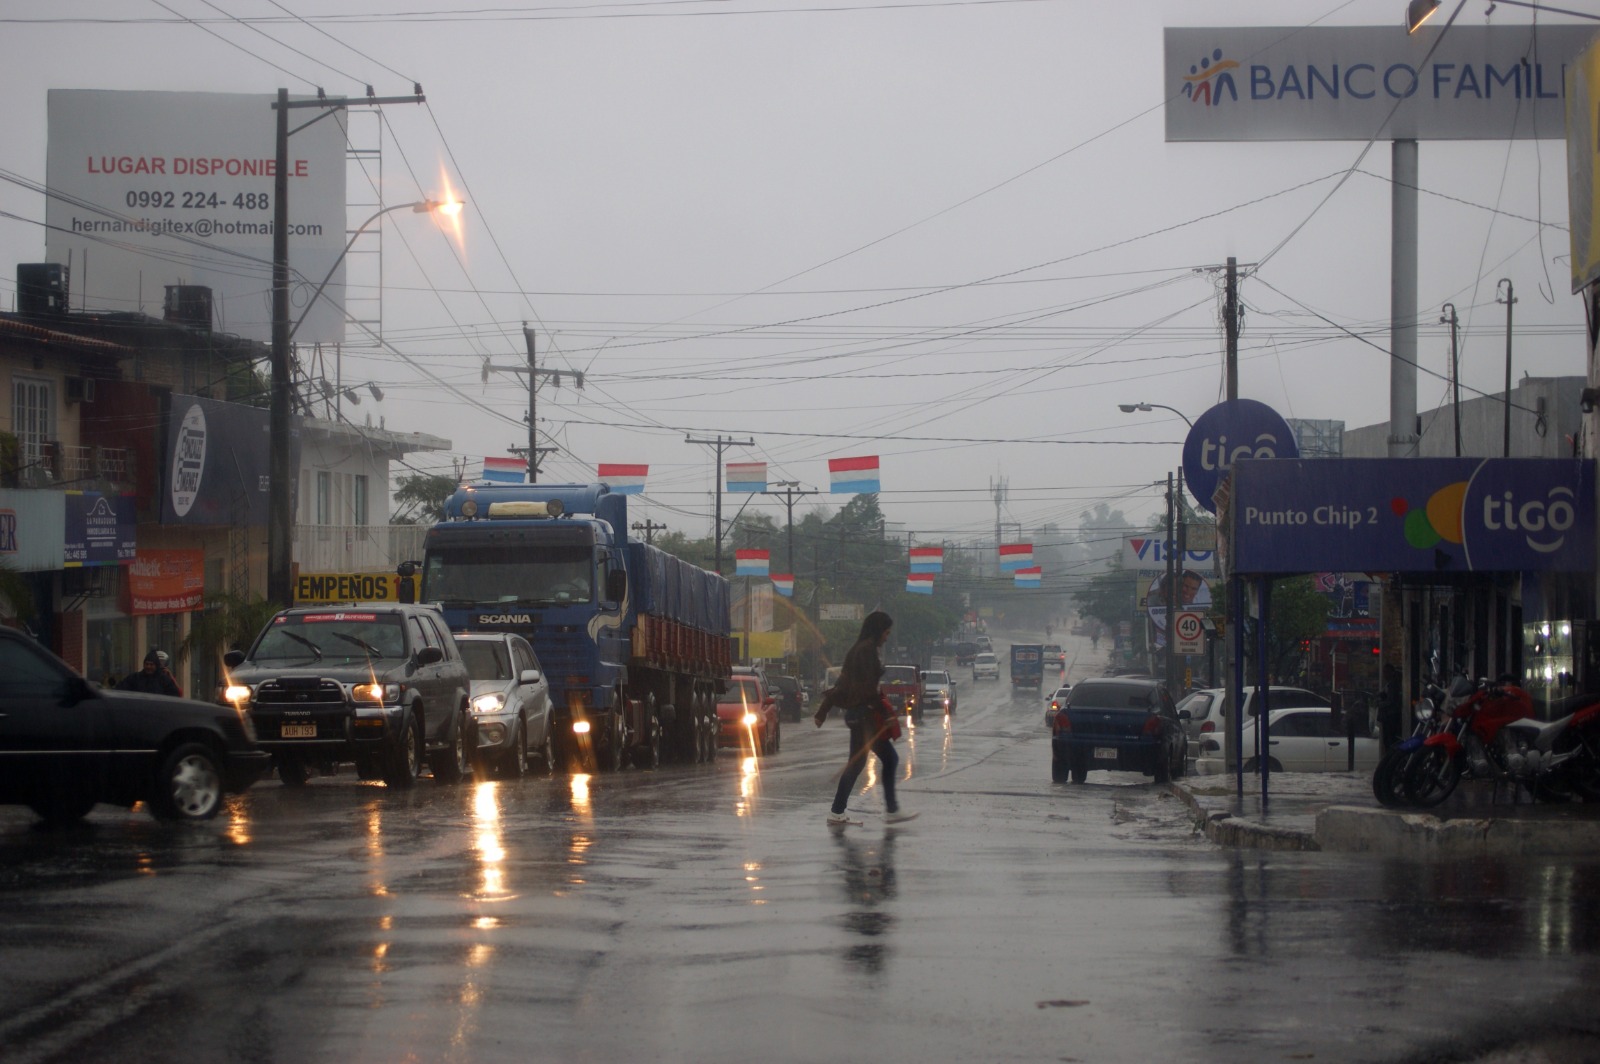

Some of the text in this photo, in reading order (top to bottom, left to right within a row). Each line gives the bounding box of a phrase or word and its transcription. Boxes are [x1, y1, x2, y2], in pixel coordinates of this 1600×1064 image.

[1250, 63, 1419, 100] BANCO
[87, 156, 309, 176] LUGAR DISPONIBE
[126, 191, 175, 208] 0992
[233, 193, 269, 210] 488
[71, 216, 323, 237] hernandigitex@hotmaicom
[1245, 506, 1378, 529] Punto Chip 2
[298, 575, 388, 599] EMPEÑOS
[479, 614, 532, 624] SCANIA
[1182, 620, 1198, 632] 40
